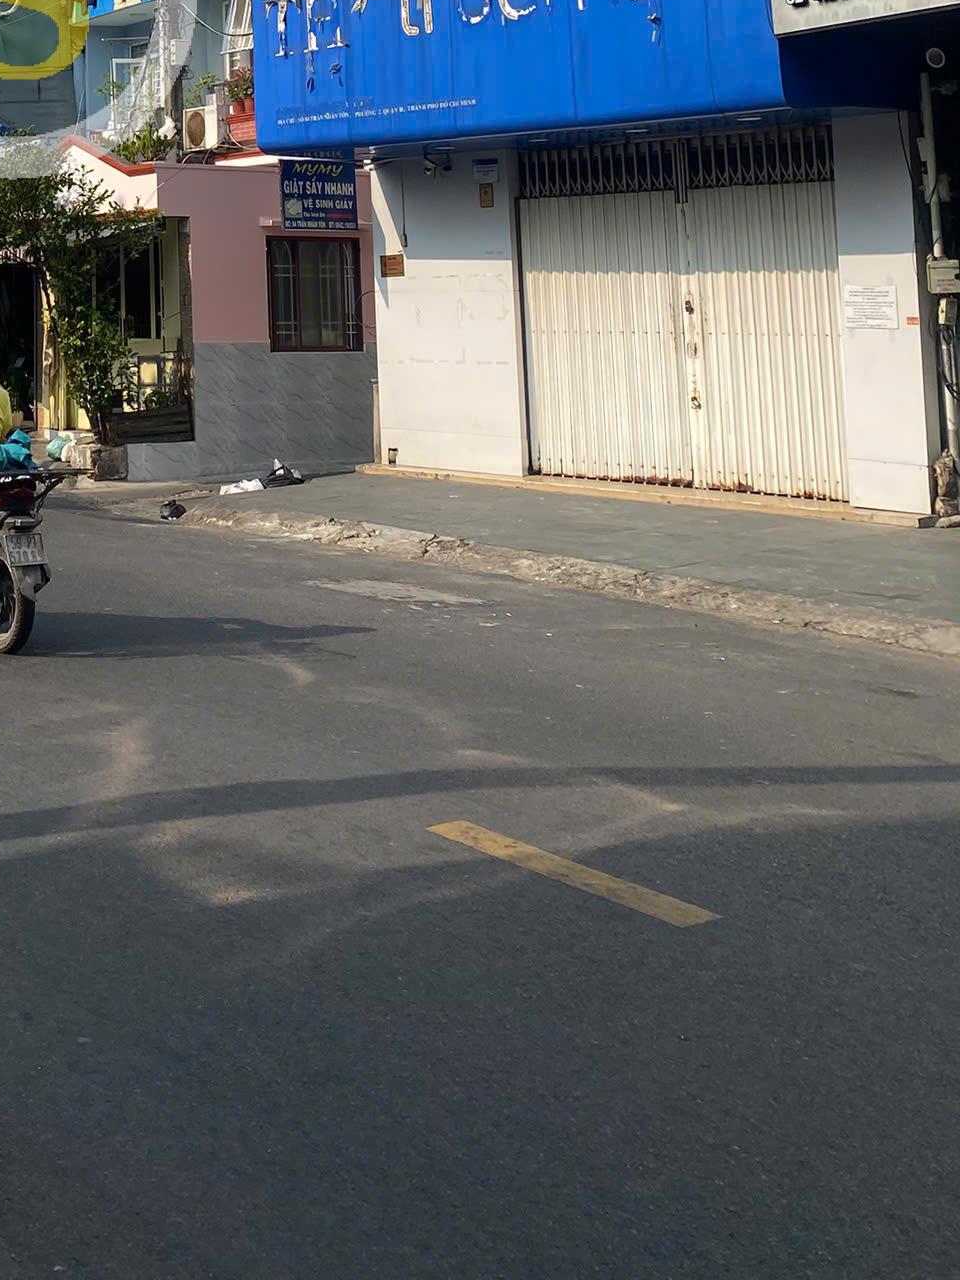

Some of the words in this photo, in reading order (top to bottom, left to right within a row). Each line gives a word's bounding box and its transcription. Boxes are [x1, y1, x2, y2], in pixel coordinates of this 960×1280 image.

[283, 177, 304, 197] GIẶT
[305, 176, 323, 195] SẤY
[324, 181, 354, 196] NHANH
[303, 197, 314, 210] VỆ
[315, 199, 334, 209] SINH
